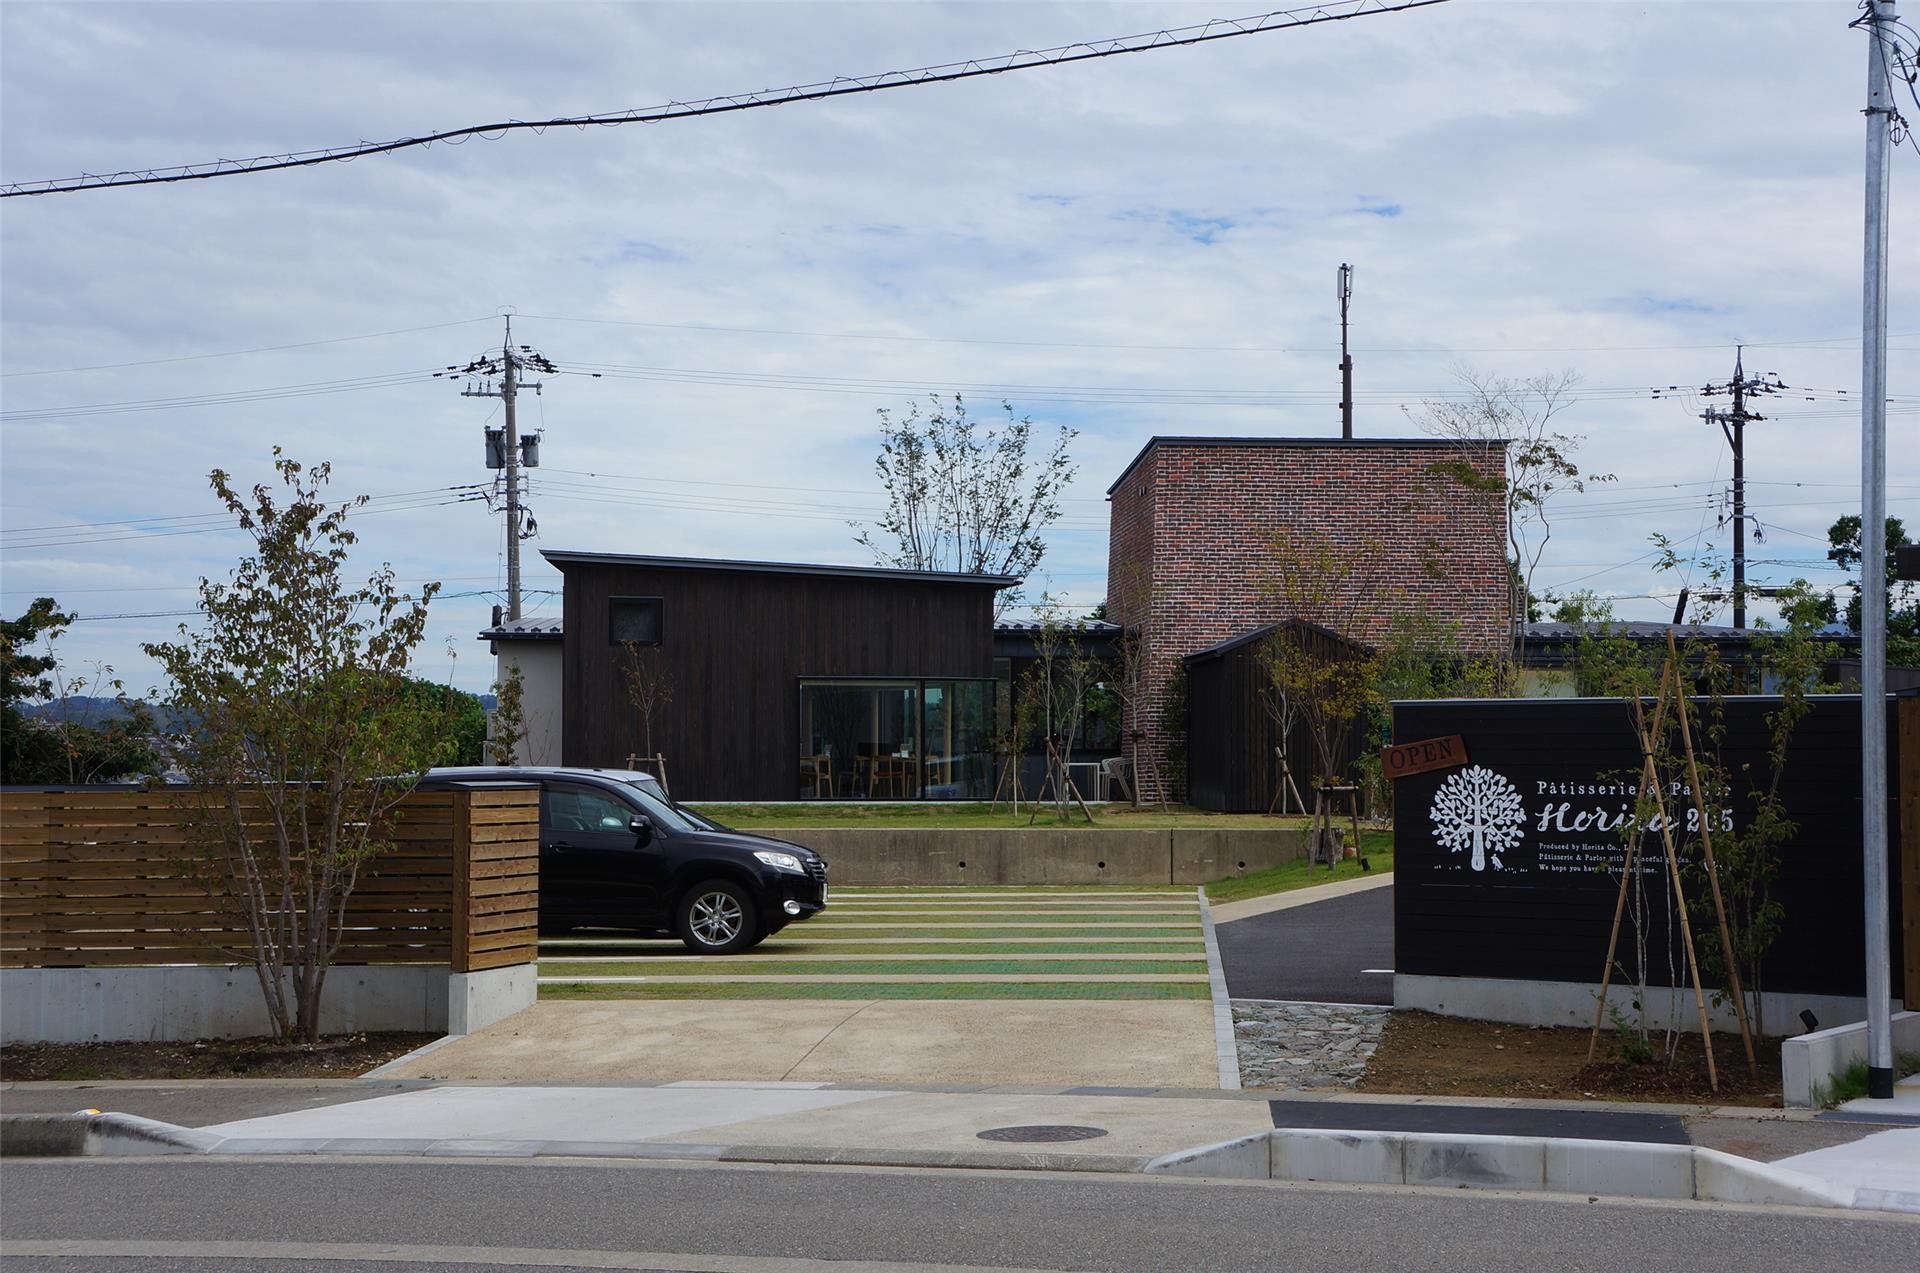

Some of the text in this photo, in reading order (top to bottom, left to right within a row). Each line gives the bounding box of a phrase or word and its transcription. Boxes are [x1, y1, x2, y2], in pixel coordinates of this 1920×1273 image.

[1390, 738, 1454, 770] OPEN
[1536, 781, 1636, 795] Pâtisserie
[1534, 802, 1680, 832] Horia
[1538, 842, 1569, 850] Produced
[1571, 843, 1580, 852] by
[1582, 843, 1605, 851] Horita
[1633, 856, 1663, 864] paceful
[1538, 863, 1549, 871] We
[1551, 864, 1567, 873] hope
